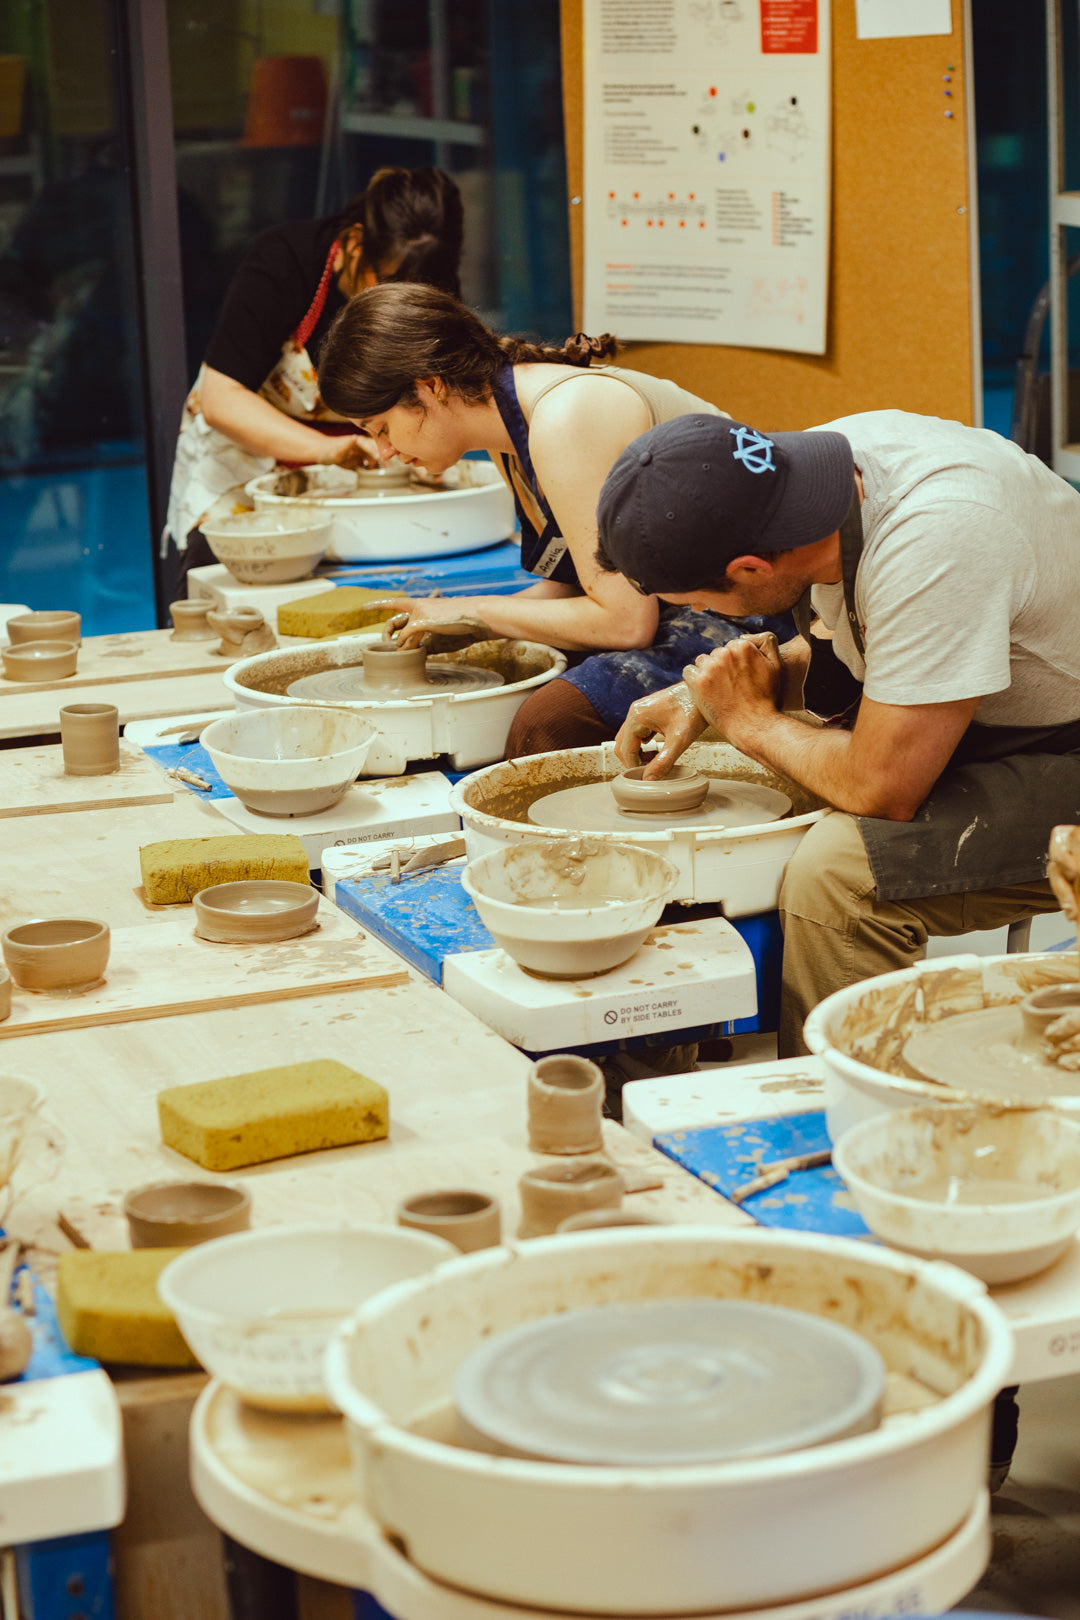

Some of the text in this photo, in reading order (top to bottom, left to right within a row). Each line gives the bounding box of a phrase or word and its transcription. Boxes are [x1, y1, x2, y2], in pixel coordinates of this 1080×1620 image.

[539, 547, 563, 572] Amelia
[620, 1000, 678, 1015] DO NOT CARRY
[620, 1008, 682, 1024] BY SIDE TABLES
